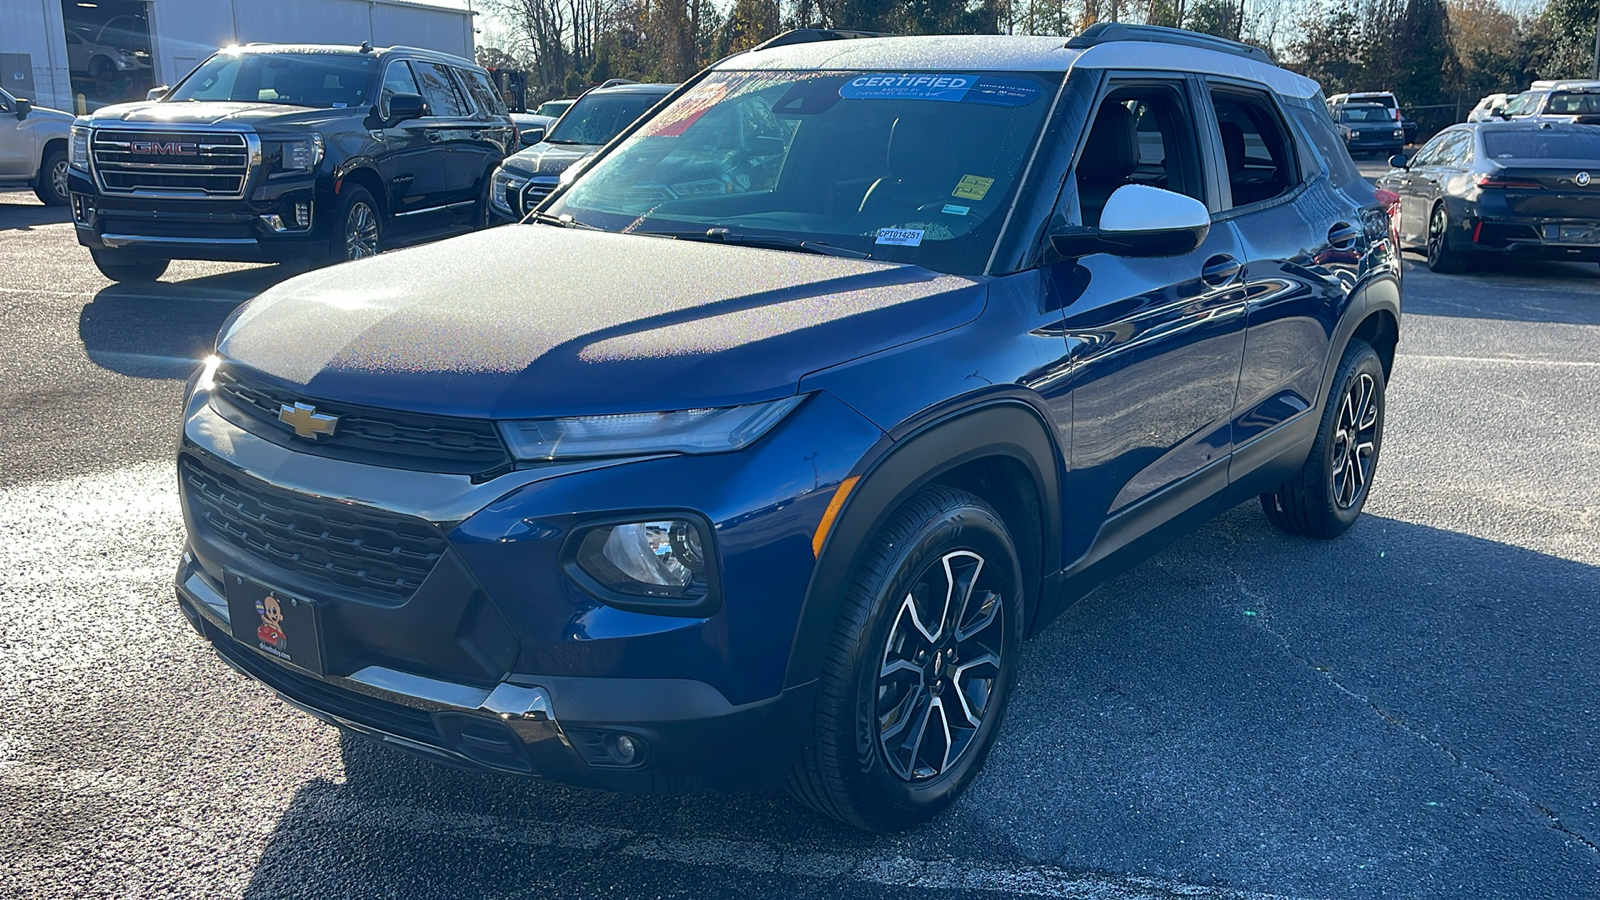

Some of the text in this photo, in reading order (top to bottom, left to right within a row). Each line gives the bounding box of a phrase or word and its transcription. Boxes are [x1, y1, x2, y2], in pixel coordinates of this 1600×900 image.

[851, 77, 967, 88] CERTIFIED
[131, 141, 197, 155] GMC
[879, 230, 921, 239] CPT014251
[259, 642, 291, 661] drivebaby.com
